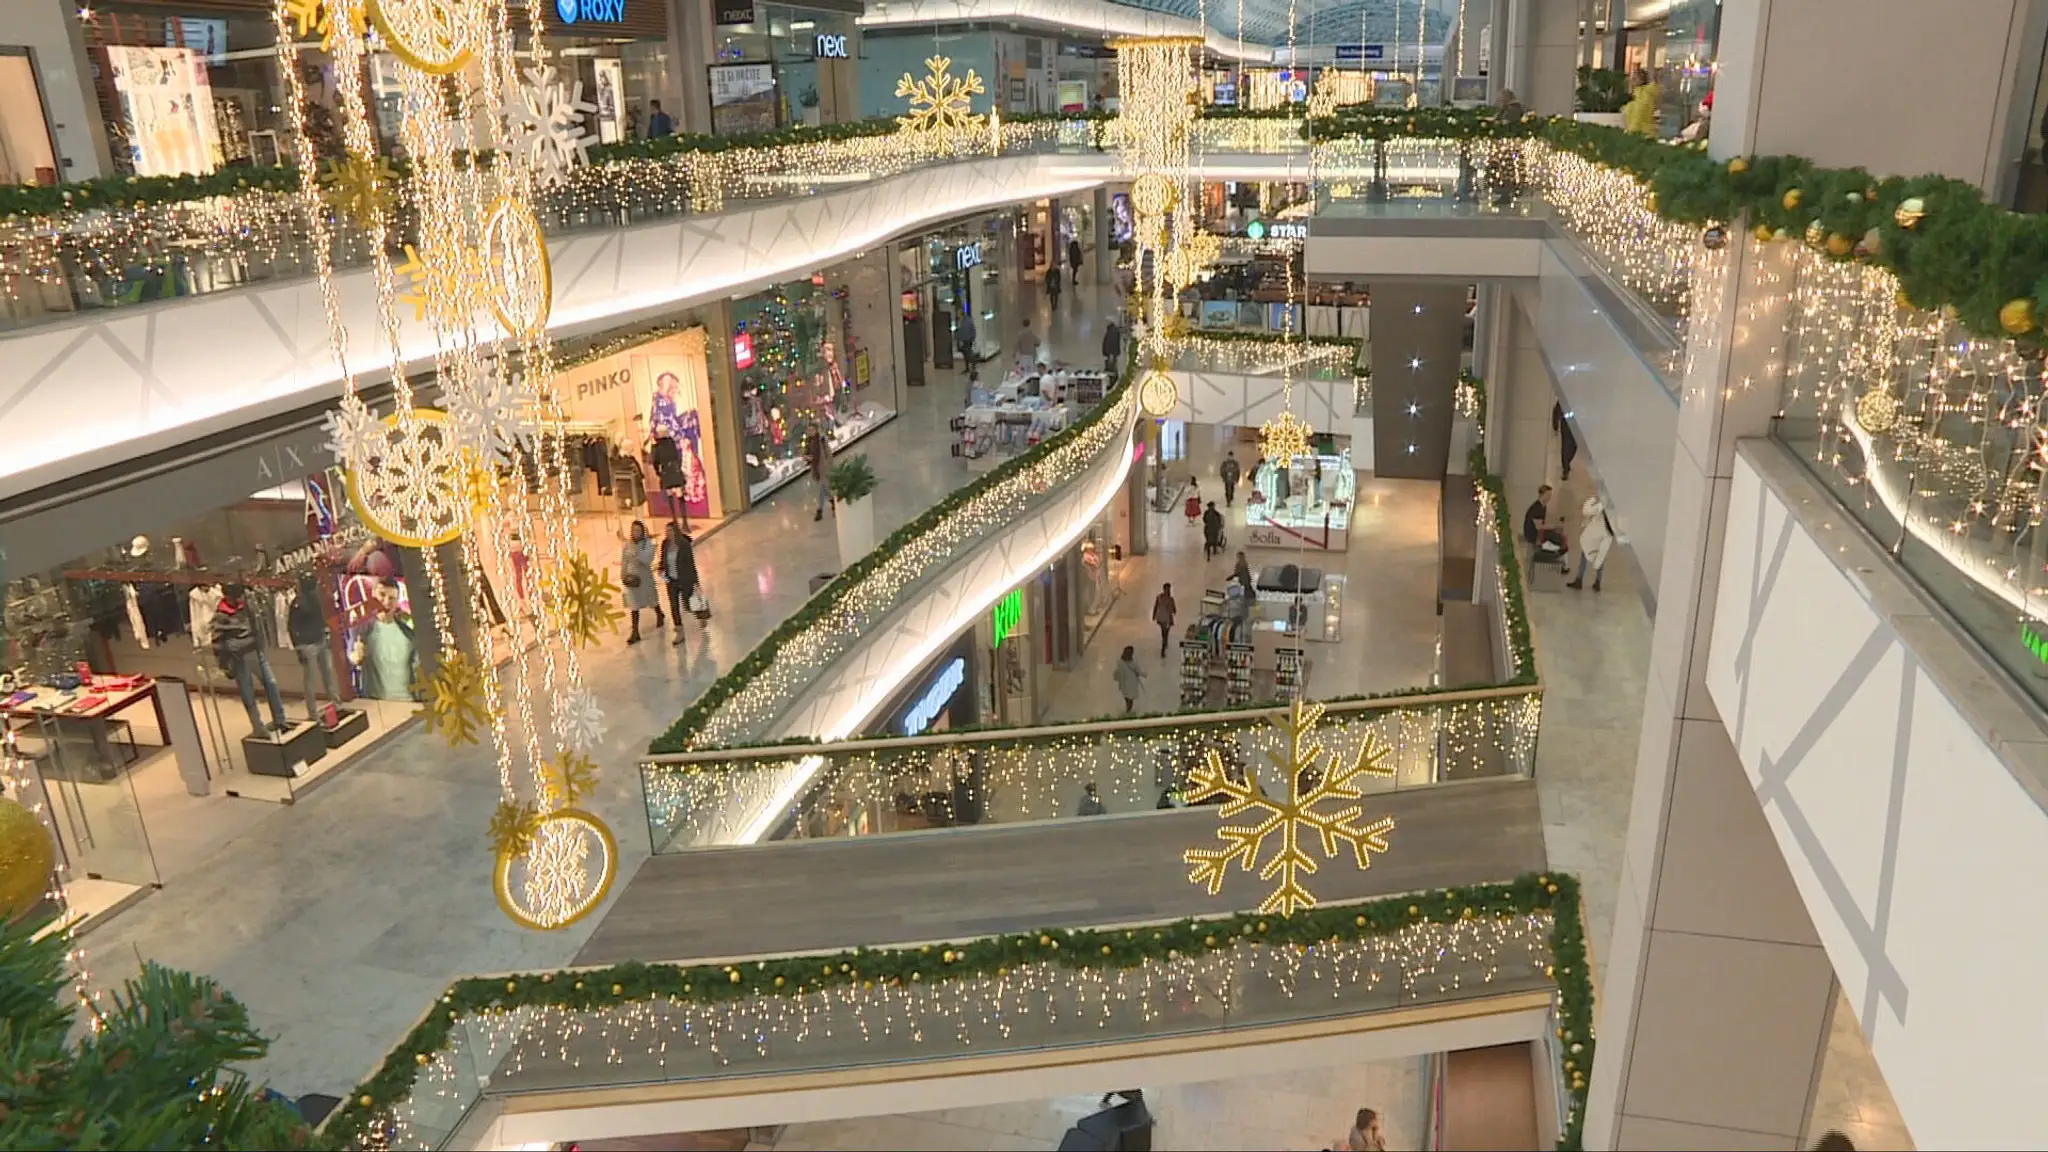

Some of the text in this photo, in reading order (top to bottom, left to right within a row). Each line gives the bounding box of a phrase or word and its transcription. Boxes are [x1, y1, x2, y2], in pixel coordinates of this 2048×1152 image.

[581, 0, 624, 22] ROXY
[723, 9, 753, 21] next
[816, 33, 849, 57] next
[1270, 224, 1307, 238] STAR
[956, 242, 982, 271] next
[577, 368, 631, 401] PINKO
[275, 538, 330, 575] ARMANI
